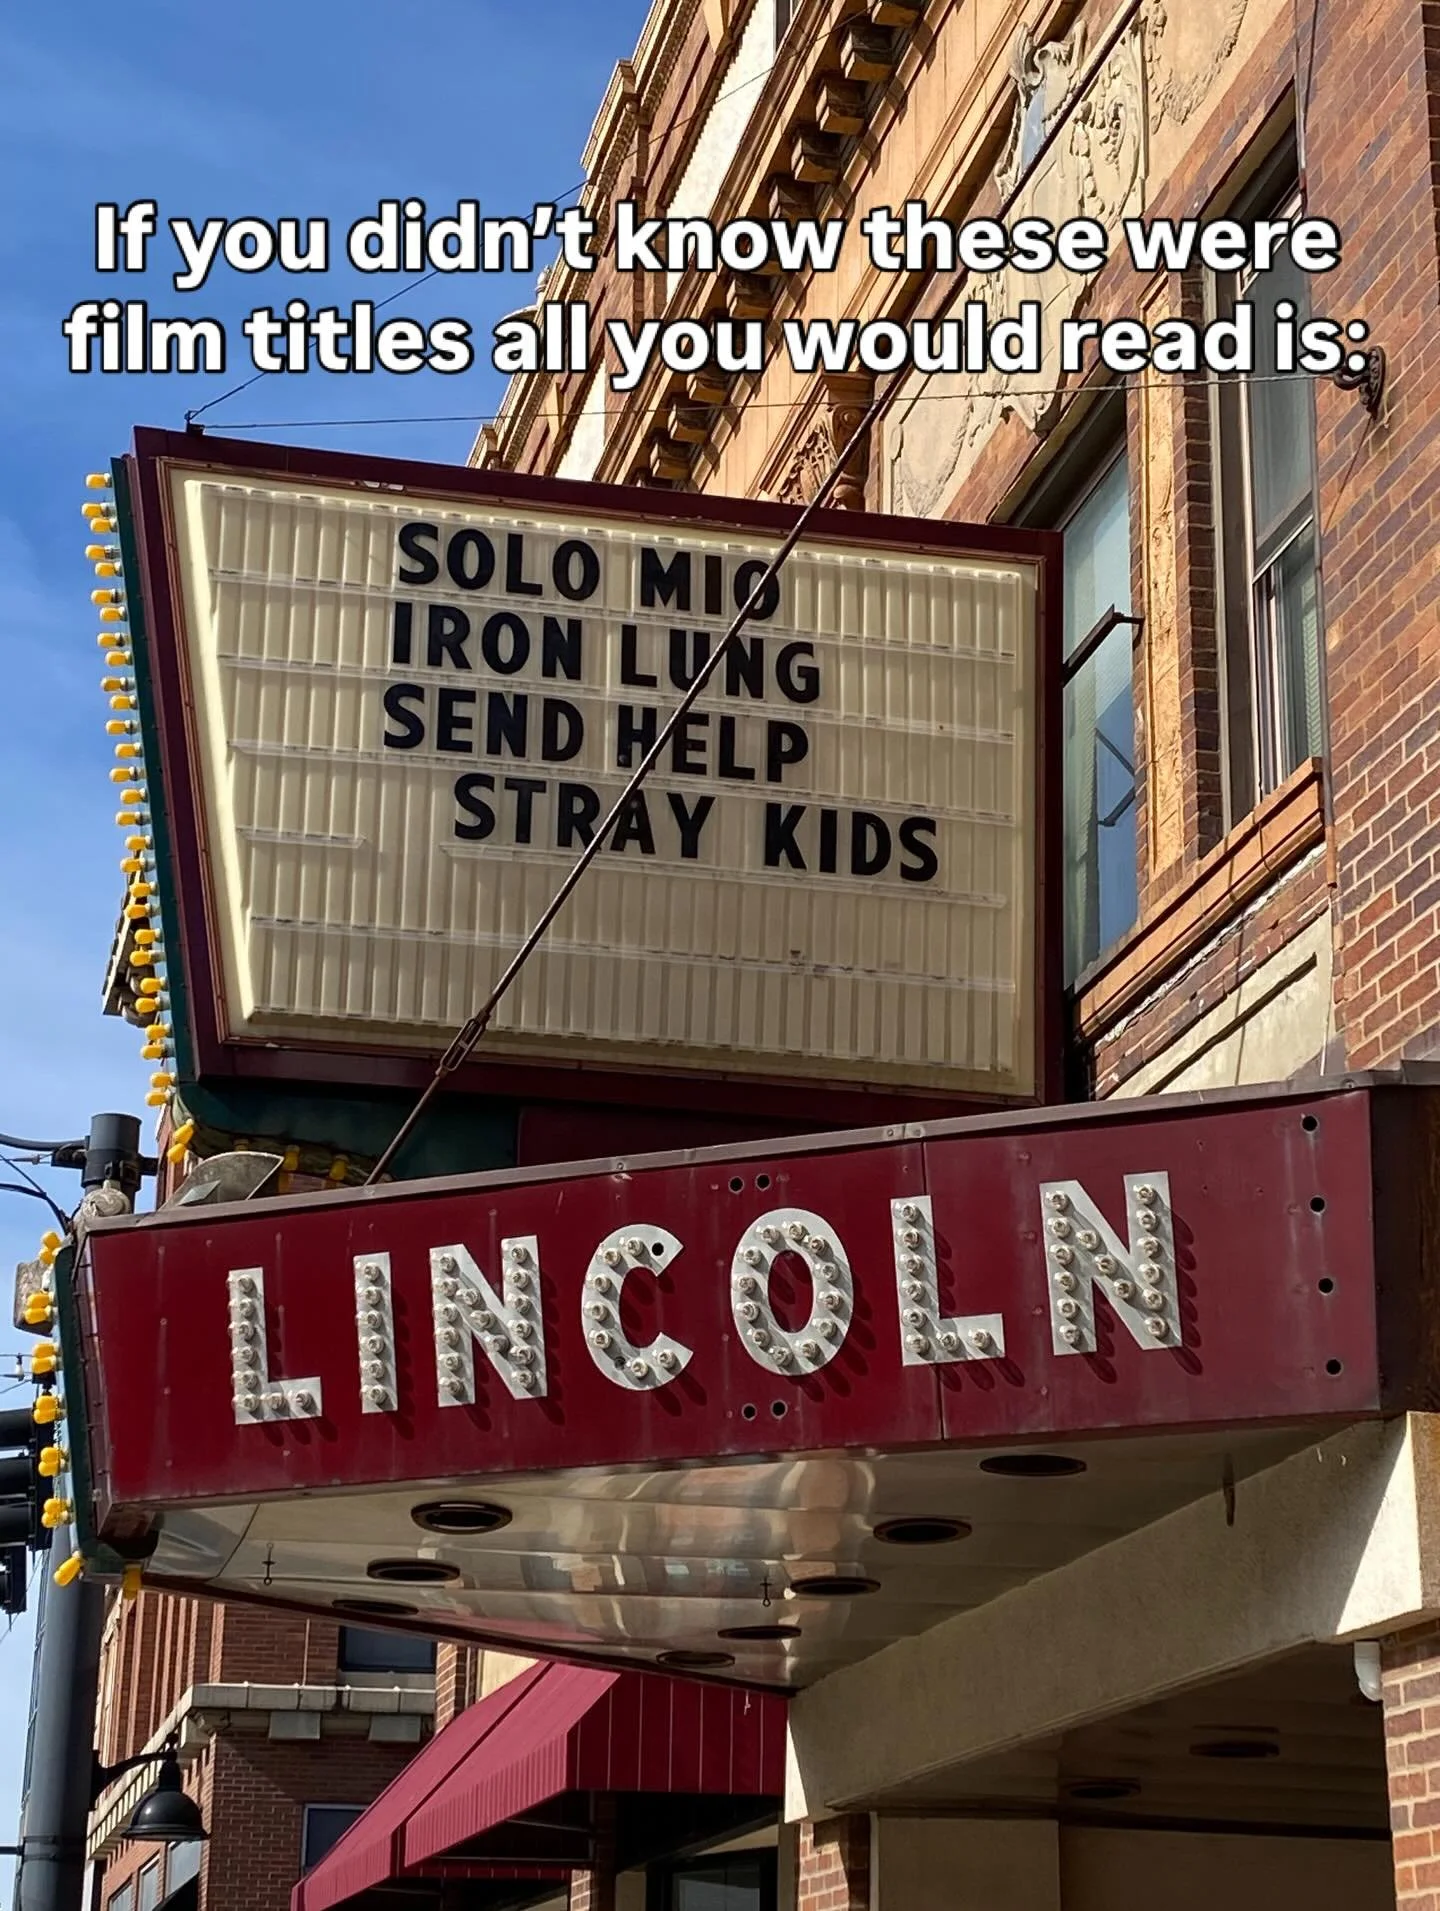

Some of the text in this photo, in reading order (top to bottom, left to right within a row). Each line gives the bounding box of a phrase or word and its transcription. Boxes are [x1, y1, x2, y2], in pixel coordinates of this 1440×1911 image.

[398, 522, 781, 621] SOLO MIO
[392, 601, 821, 704] IRON LUNG
[383, 683, 809, 783] SEND HELP
[454, 773, 939, 882] STRAY KIDS
[226, 1170, 1182, 1426] LINCOLN
